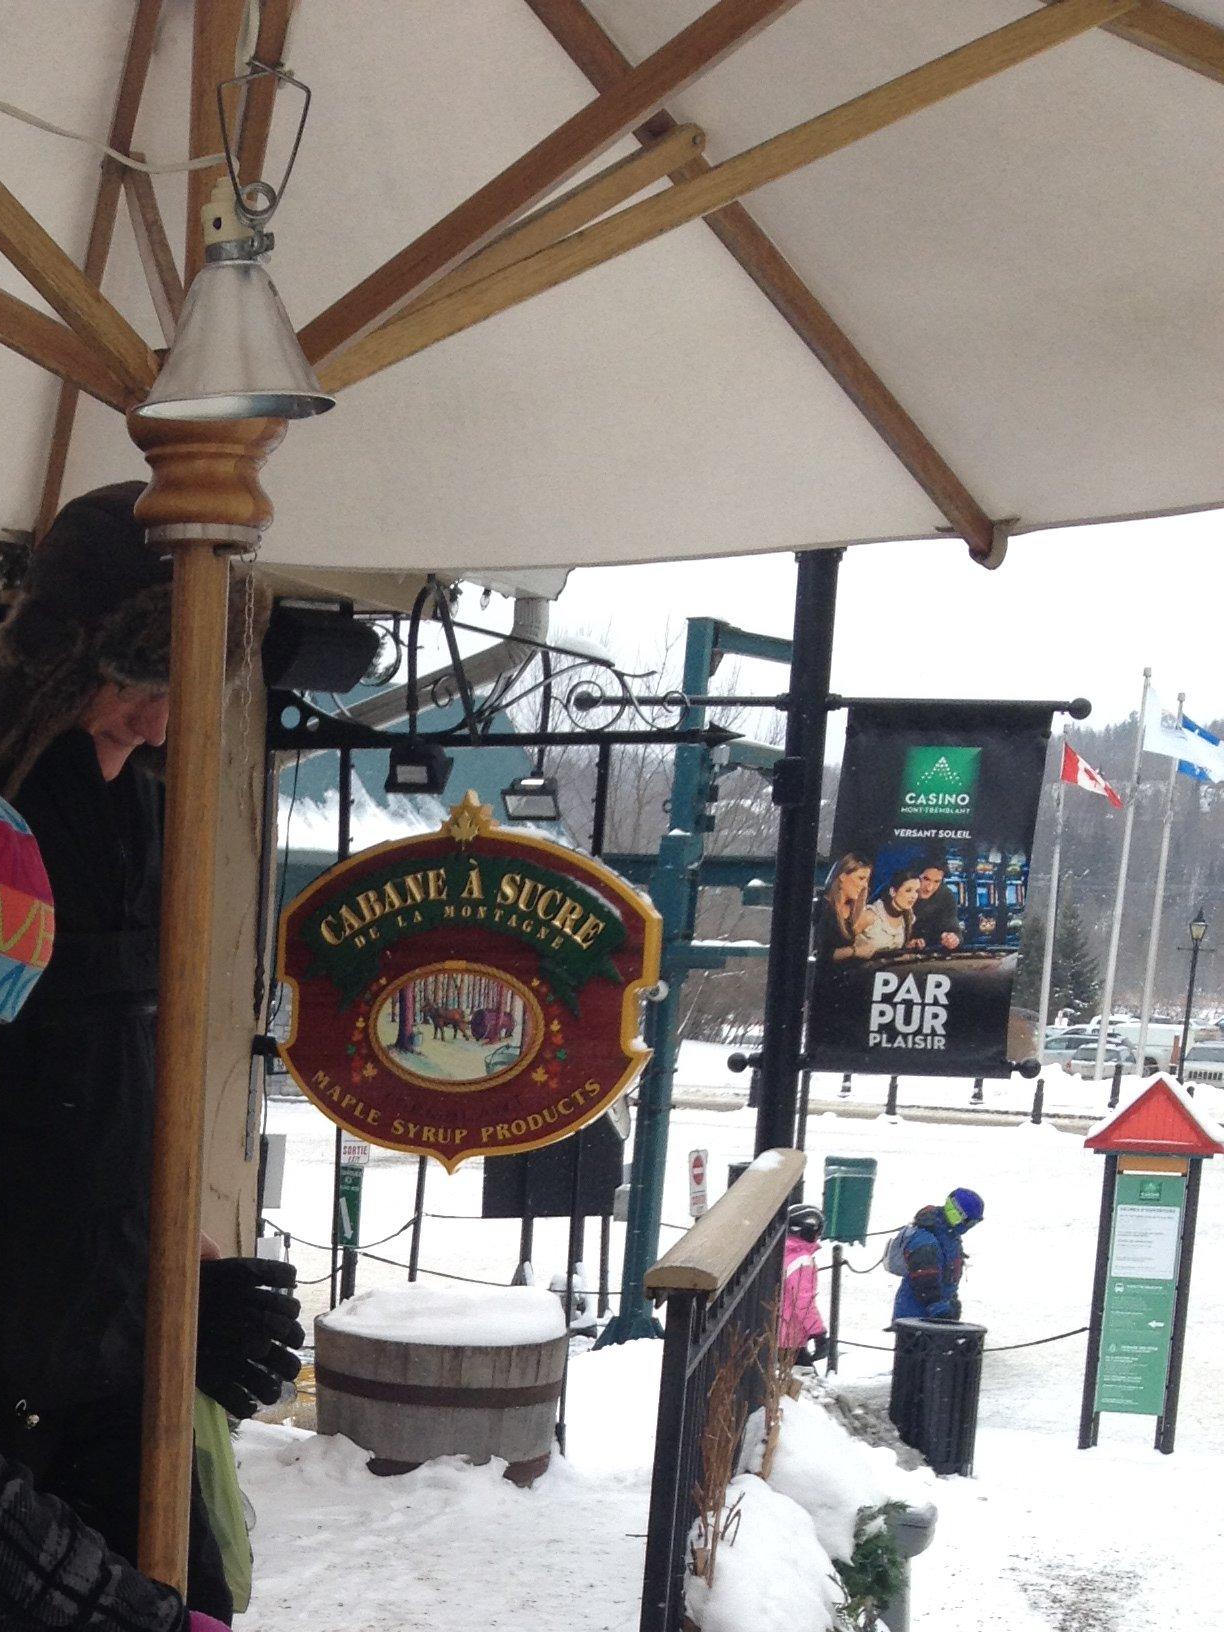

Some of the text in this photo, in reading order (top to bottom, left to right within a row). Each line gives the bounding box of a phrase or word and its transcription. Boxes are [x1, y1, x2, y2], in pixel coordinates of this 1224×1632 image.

[905, 792, 970, 805] CASINO
[894, 829, 972, 839] VERSANT SOLEIL
[320, 858, 606, 950] CABANE À SUCRE
[354, 905, 564, 949] DE LA MONTAGNE
[872, 971, 951, 1004] PAR
[869, 1003, 948, 1035] PUR
[869, 1033, 946, 1050] PLAISIR
[311, 1070, 601, 1144] MAPLE SYRUP PRODUCTS
[343, 1145, 367, 1155] SORTIE
